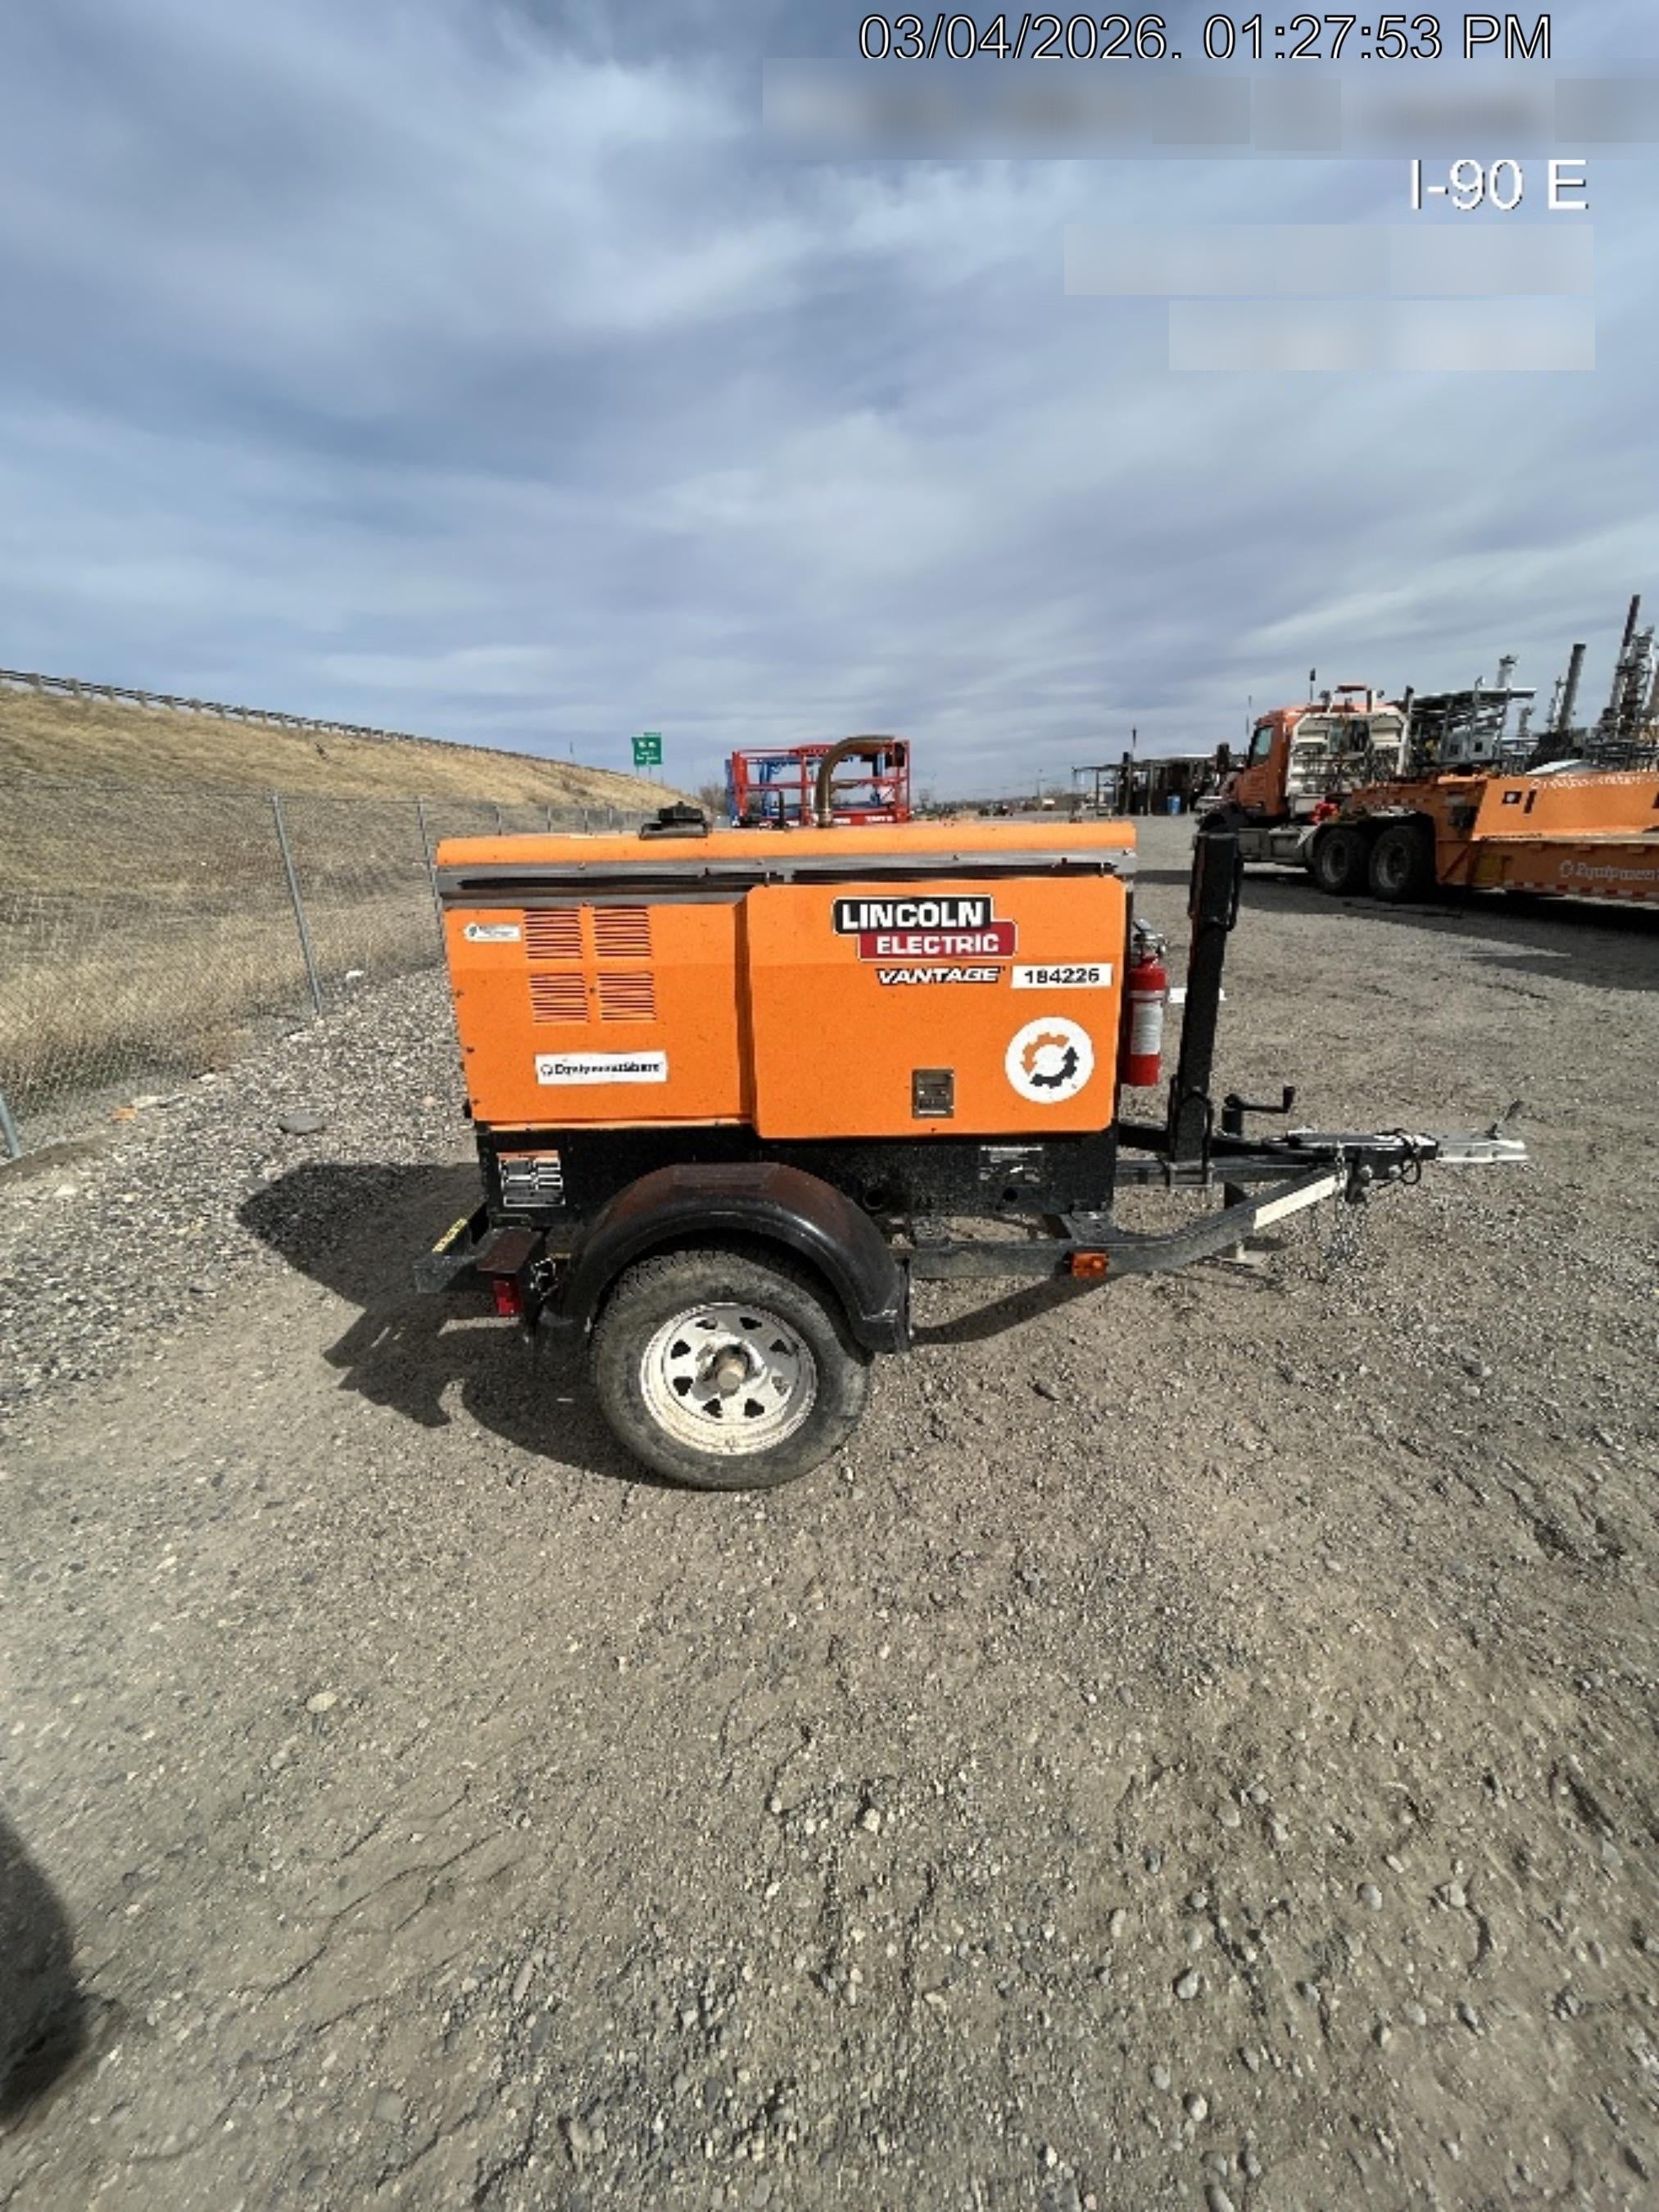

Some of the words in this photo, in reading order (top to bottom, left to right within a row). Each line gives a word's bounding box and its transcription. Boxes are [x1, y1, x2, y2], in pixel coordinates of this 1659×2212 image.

[841, 901, 985, 930] LINCOLN
[876, 933, 999, 954] ELECTRIC
[876, 966, 1001, 984] VANTAGE
[1024, 968, 1100, 984] 184226
